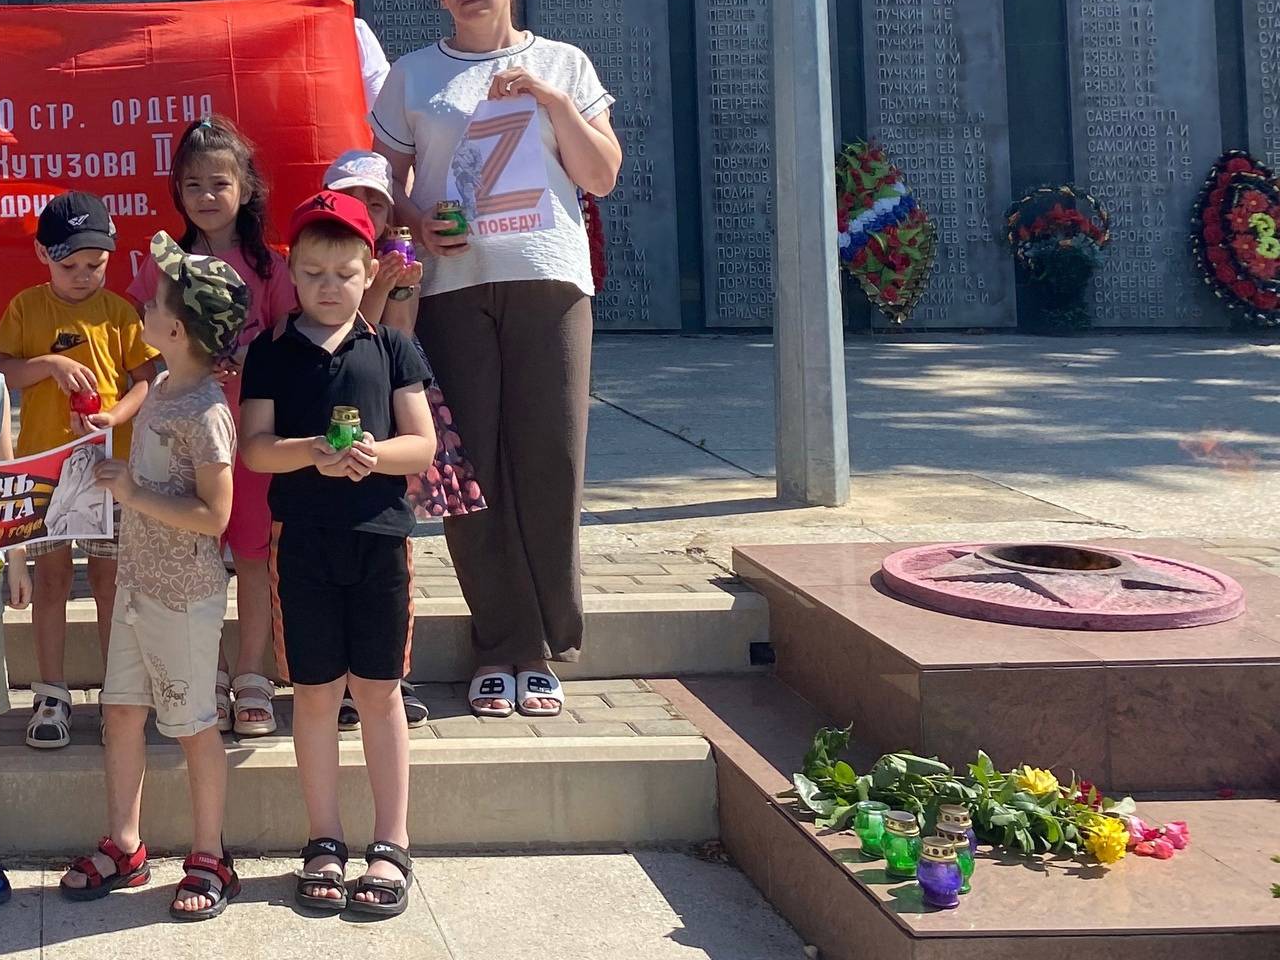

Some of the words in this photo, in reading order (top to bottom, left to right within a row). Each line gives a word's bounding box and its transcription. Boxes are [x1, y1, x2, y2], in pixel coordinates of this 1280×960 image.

[374, 13, 440, 25] МЕНДЕЛЕВ
[876, 8, 923, 20] ПУЧКИН
[877, 24, 924, 35] ПУЧКИН
[878, 38, 925, 49] ПУЧКИН
[879, 68, 926, 79] ПУЧКИН
[880, 83, 927, 95] ПУЧКИН
[30, 102, 86, 130] СТР.
[111, 94, 213, 125] ОРДЕНА
[1086, 110, 1145, 121] САВЕНКО
[477, 212, 542, 236] ПОБЕДУ!
